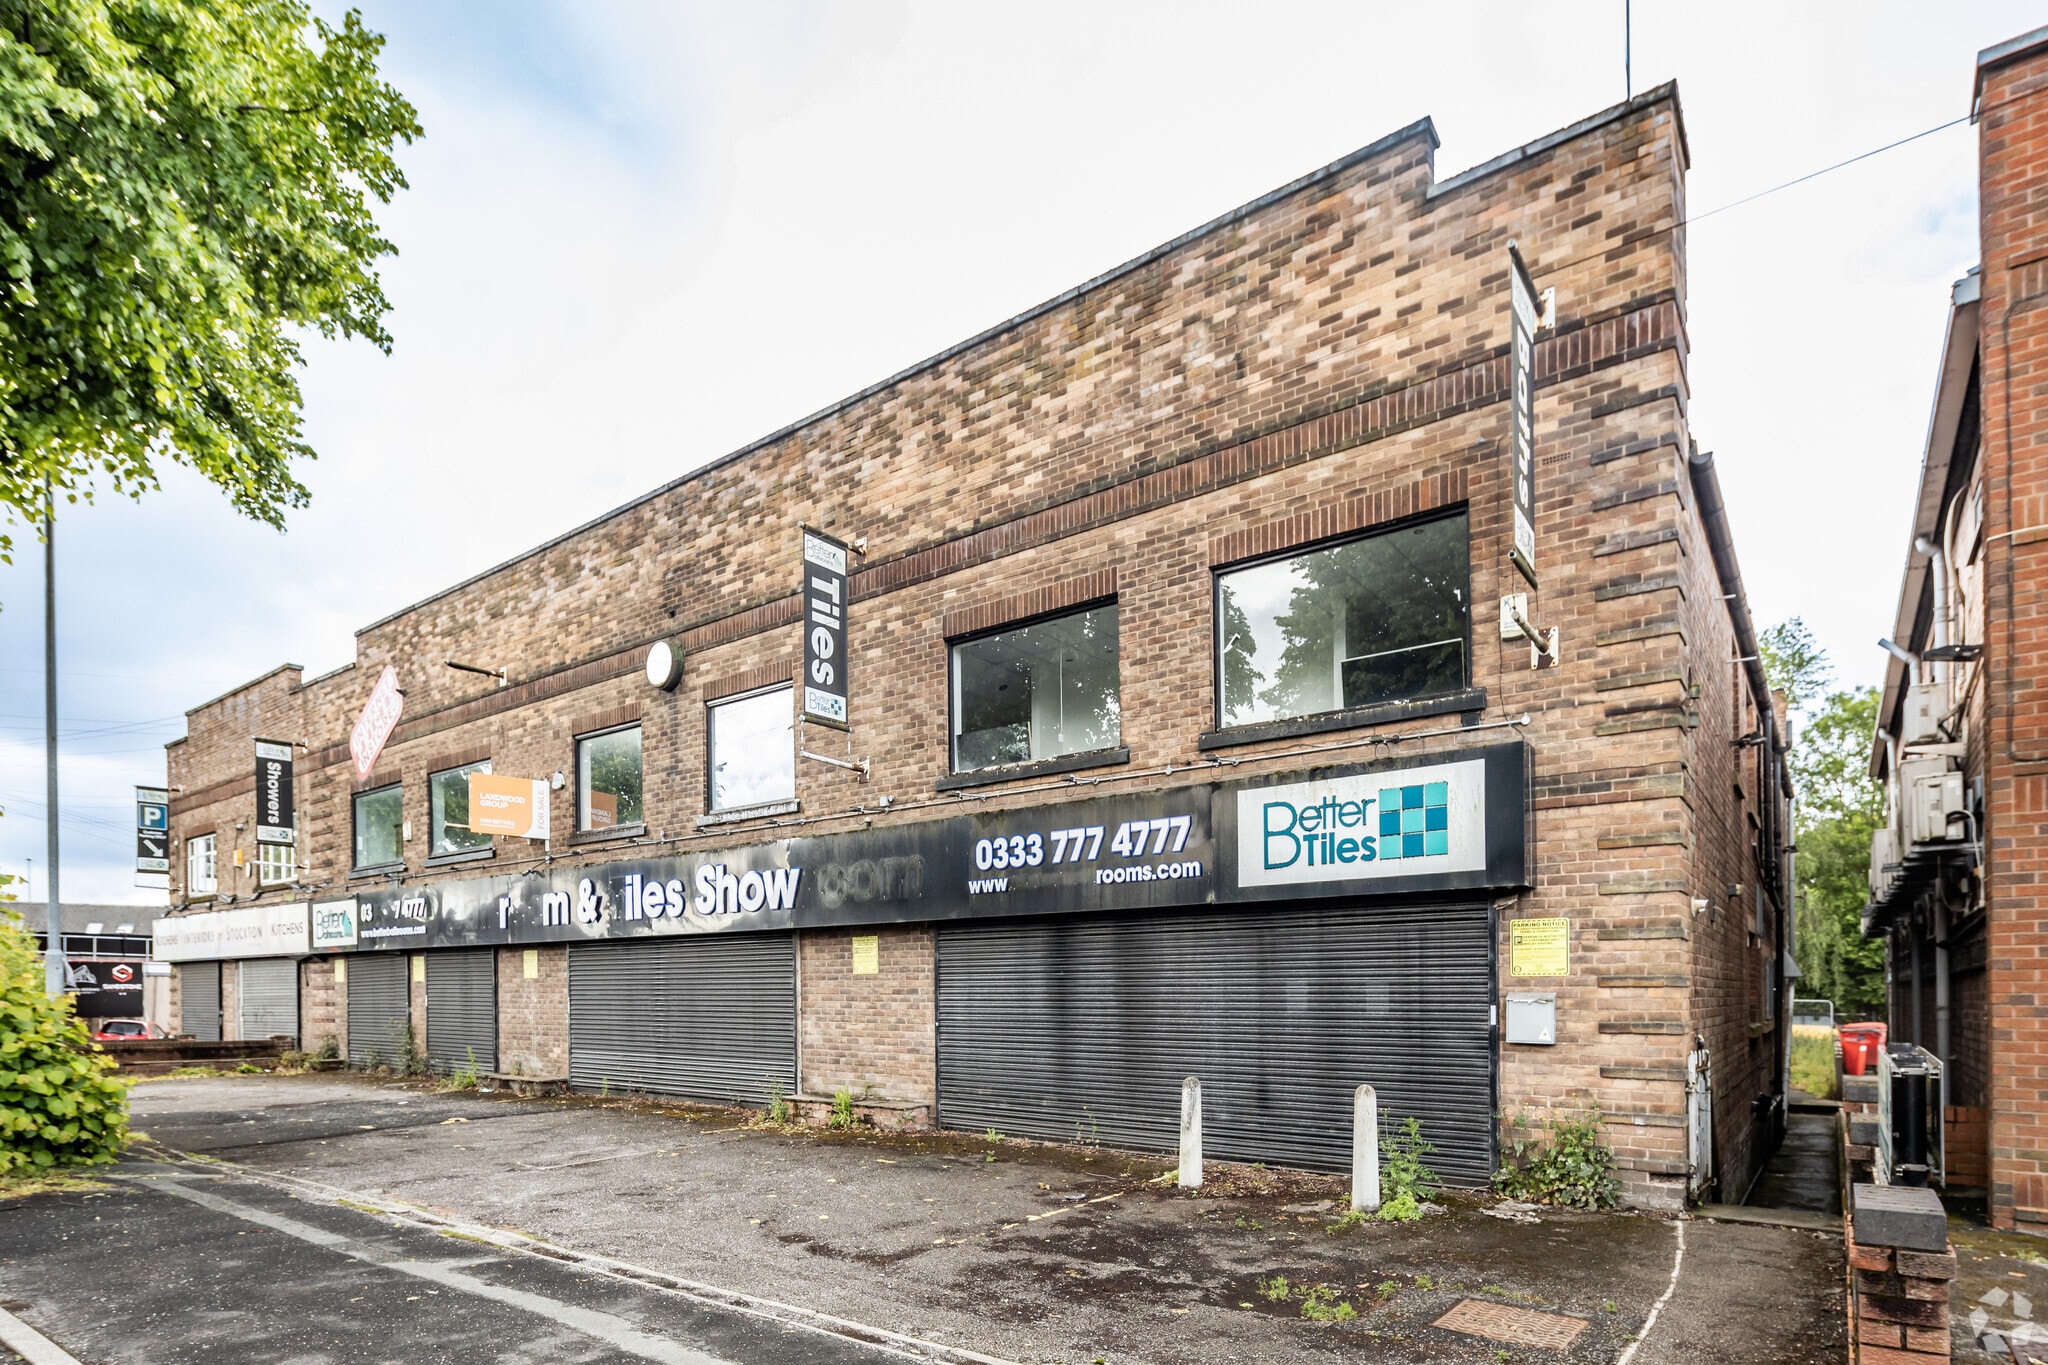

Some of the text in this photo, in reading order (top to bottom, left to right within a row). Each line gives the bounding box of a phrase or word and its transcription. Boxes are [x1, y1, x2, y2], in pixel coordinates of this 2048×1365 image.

[1517, 325, 1531, 509] Baths
[811, 576, 840, 686] Tiles
[817, 702, 831, 714] Tiles
[267, 761, 282, 824] Showers
[480, 792, 525, 804] LANDWOOD
[480, 800, 508, 808] GROUP
[144, 806, 162, 826] P
[1263, 795, 1376, 869] Better
[975, 815, 1191, 871] 0333 777 4777
[1302, 831, 1377, 866] Tiles
[695, 863, 802, 916] Show
[968, 860, 1202, 894] www rooms.com
[226, 925, 264, 941] STOCKTON
[271, 921, 304, 936] KITCHENS
